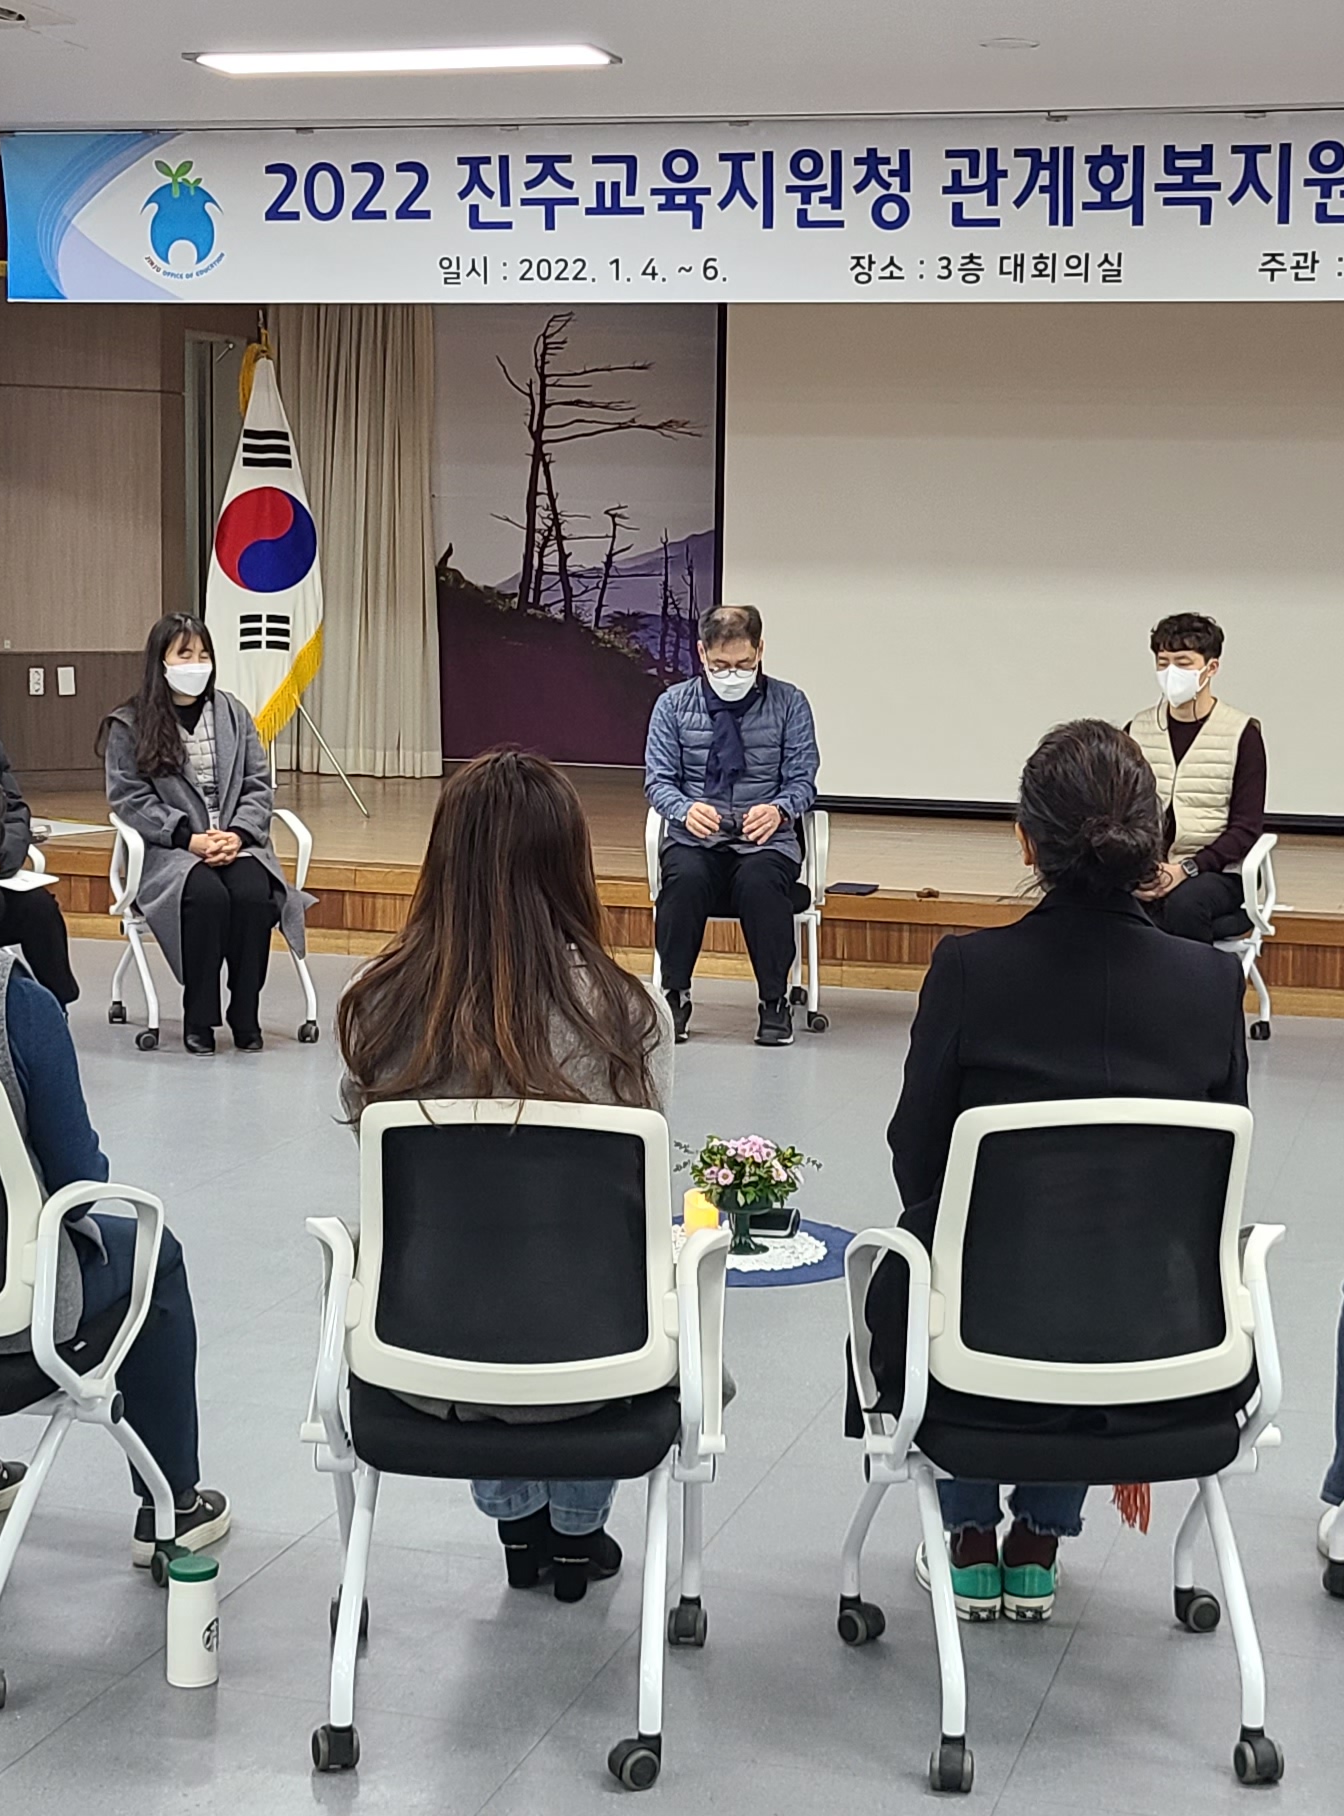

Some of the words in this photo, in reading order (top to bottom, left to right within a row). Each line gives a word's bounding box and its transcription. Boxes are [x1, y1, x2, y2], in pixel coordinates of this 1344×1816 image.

[264, 161, 432, 221] 2022
[457, 147, 911, 231] 진주교육지원청
[145, 256, 161, 273] JINJU
[162, 270, 184, 280] OFFICE
[196, 252, 225, 276] EDUCATION
[438, 255, 488, 286] 일시
[518, 257, 597, 283] 2022.
[608, 258, 632, 283] 1.
[641, 257, 667, 283] 4.
[702, 256, 728, 283] 6.
[848, 253, 906, 284] 장소
[937, 252, 985, 284] 3층
[998, 251, 1124, 284] 대회의실
[1258, 250, 1320, 282] 주관
